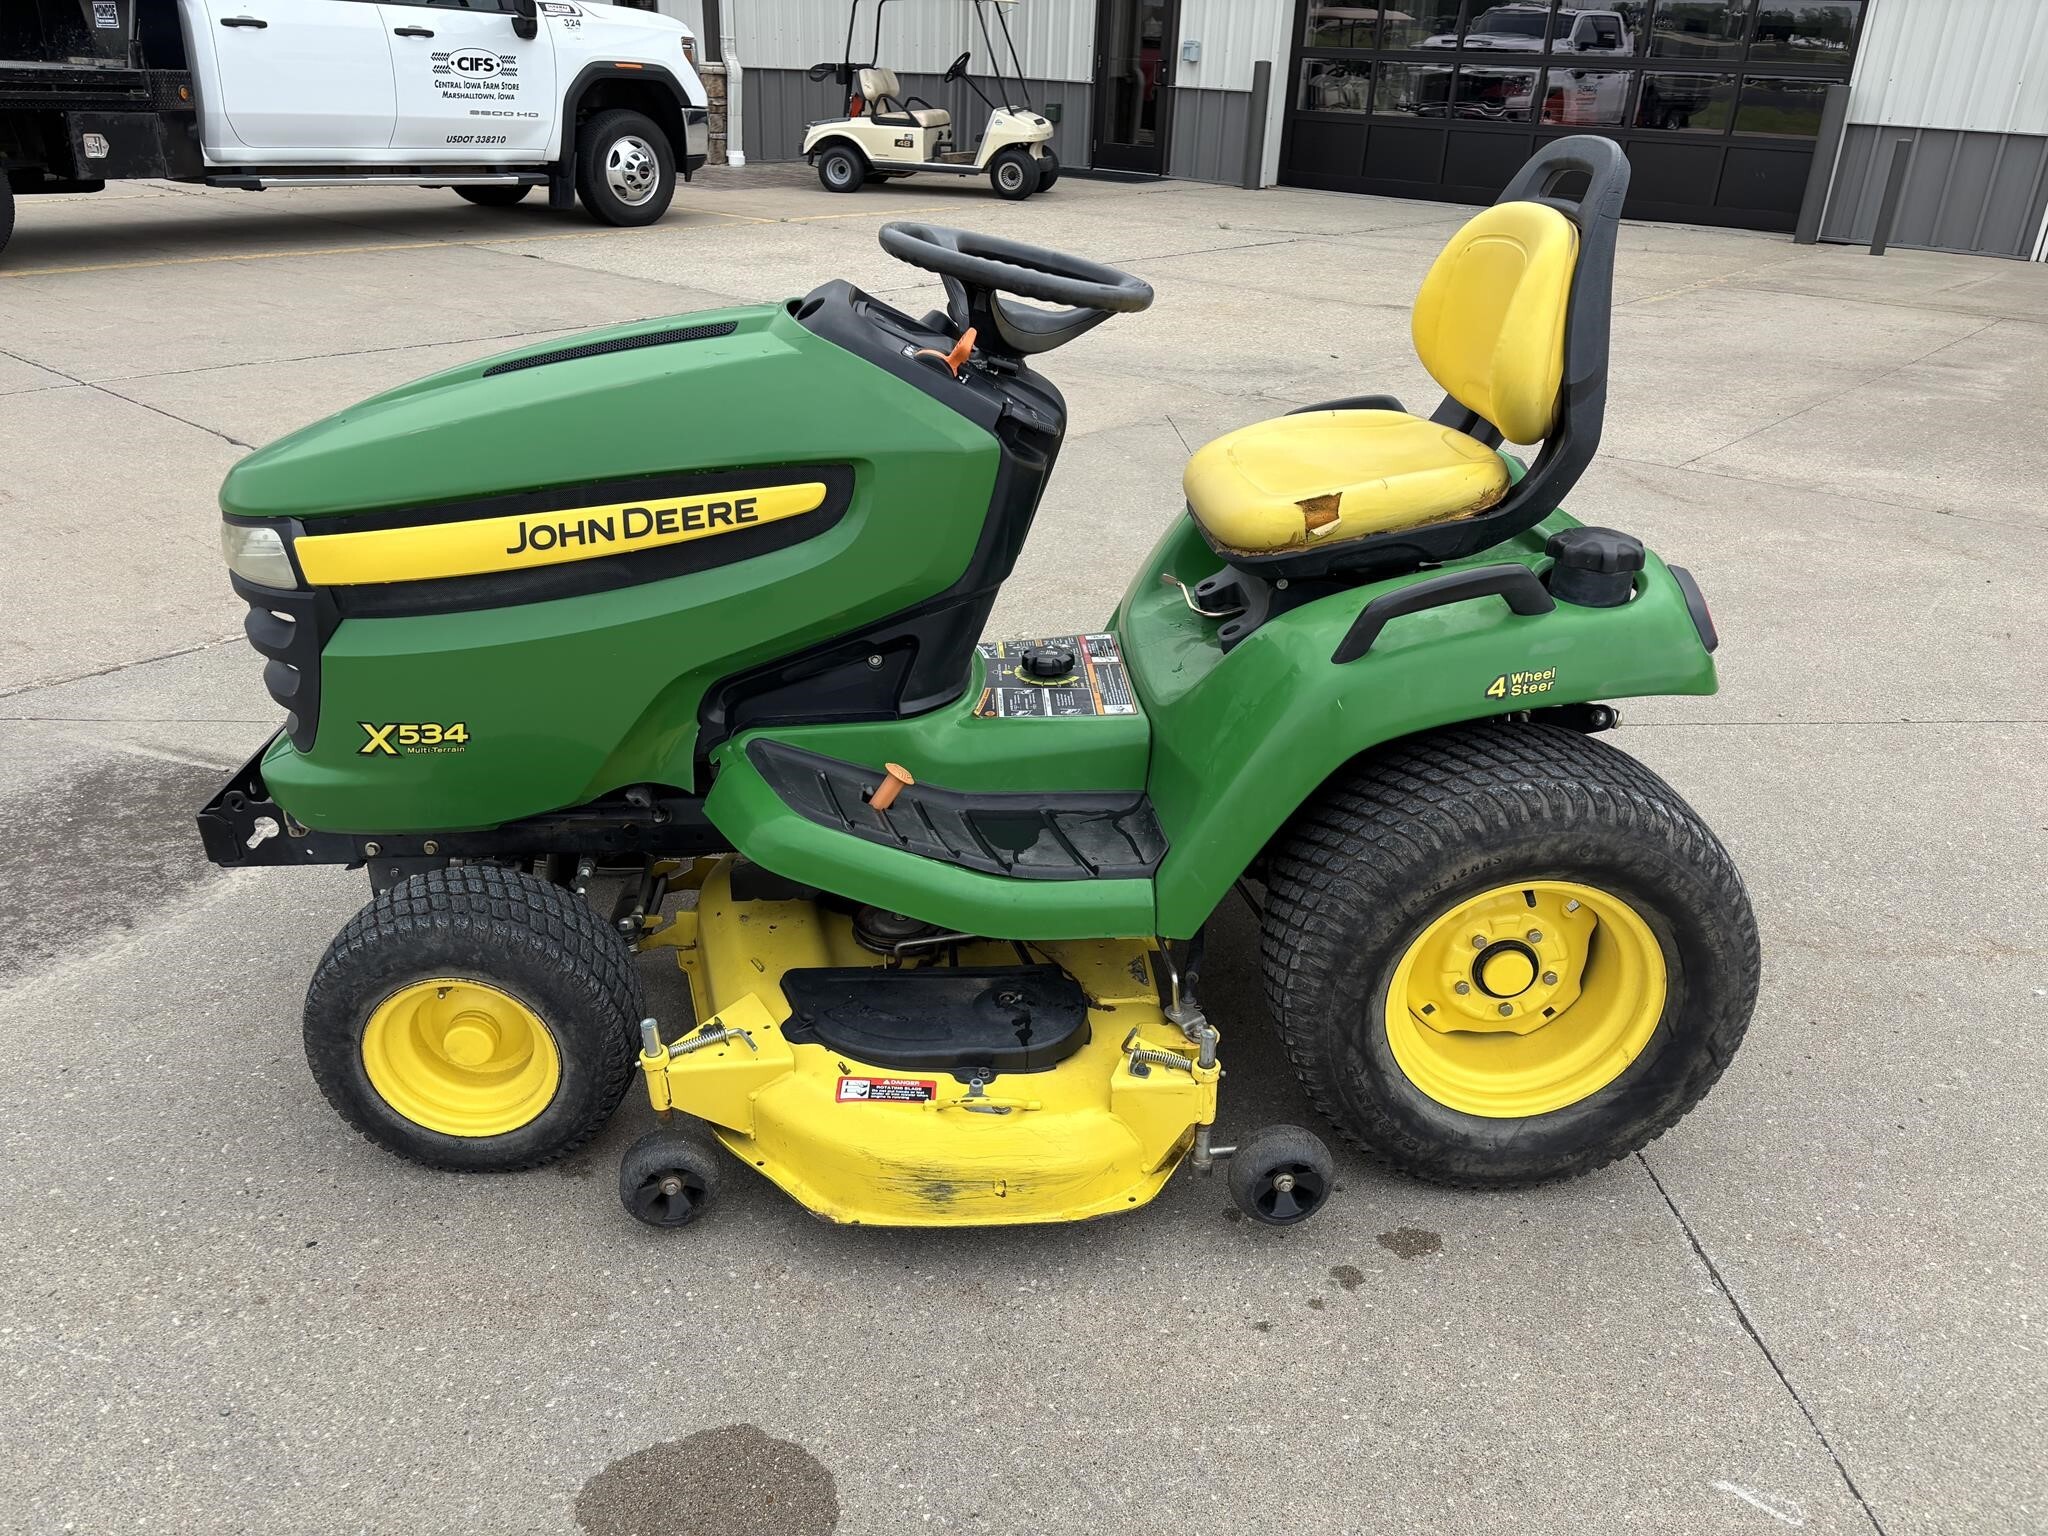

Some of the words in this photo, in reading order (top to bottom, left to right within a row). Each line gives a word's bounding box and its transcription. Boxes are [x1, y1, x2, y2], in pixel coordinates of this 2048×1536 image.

[563, 18, 581, 27] 324
[457, 56, 494, 72] CIFS
[434, 79, 462, 89] CENTRAL
[463, 80, 481, 90] IOWA
[482, 81, 500, 90] FARM
[501, 81, 520, 91] STORE
[441, 90, 496, 100] MARSHALLTOWN,
[497, 92, 515, 100] IOWA
[446, 135, 474, 144] USDOT
[475, 135, 507, 144] 338210
[506, 516, 616, 554] JOHN
[622, 497, 759, 539] DEERE
[1487, 676, 1506, 698] 4
[1511, 667, 1556, 685] Wheel
[1510, 681, 1555, 696] Steer
[359, 722, 470, 755] X534
[891, 1079, 920, 1087] DANGER
